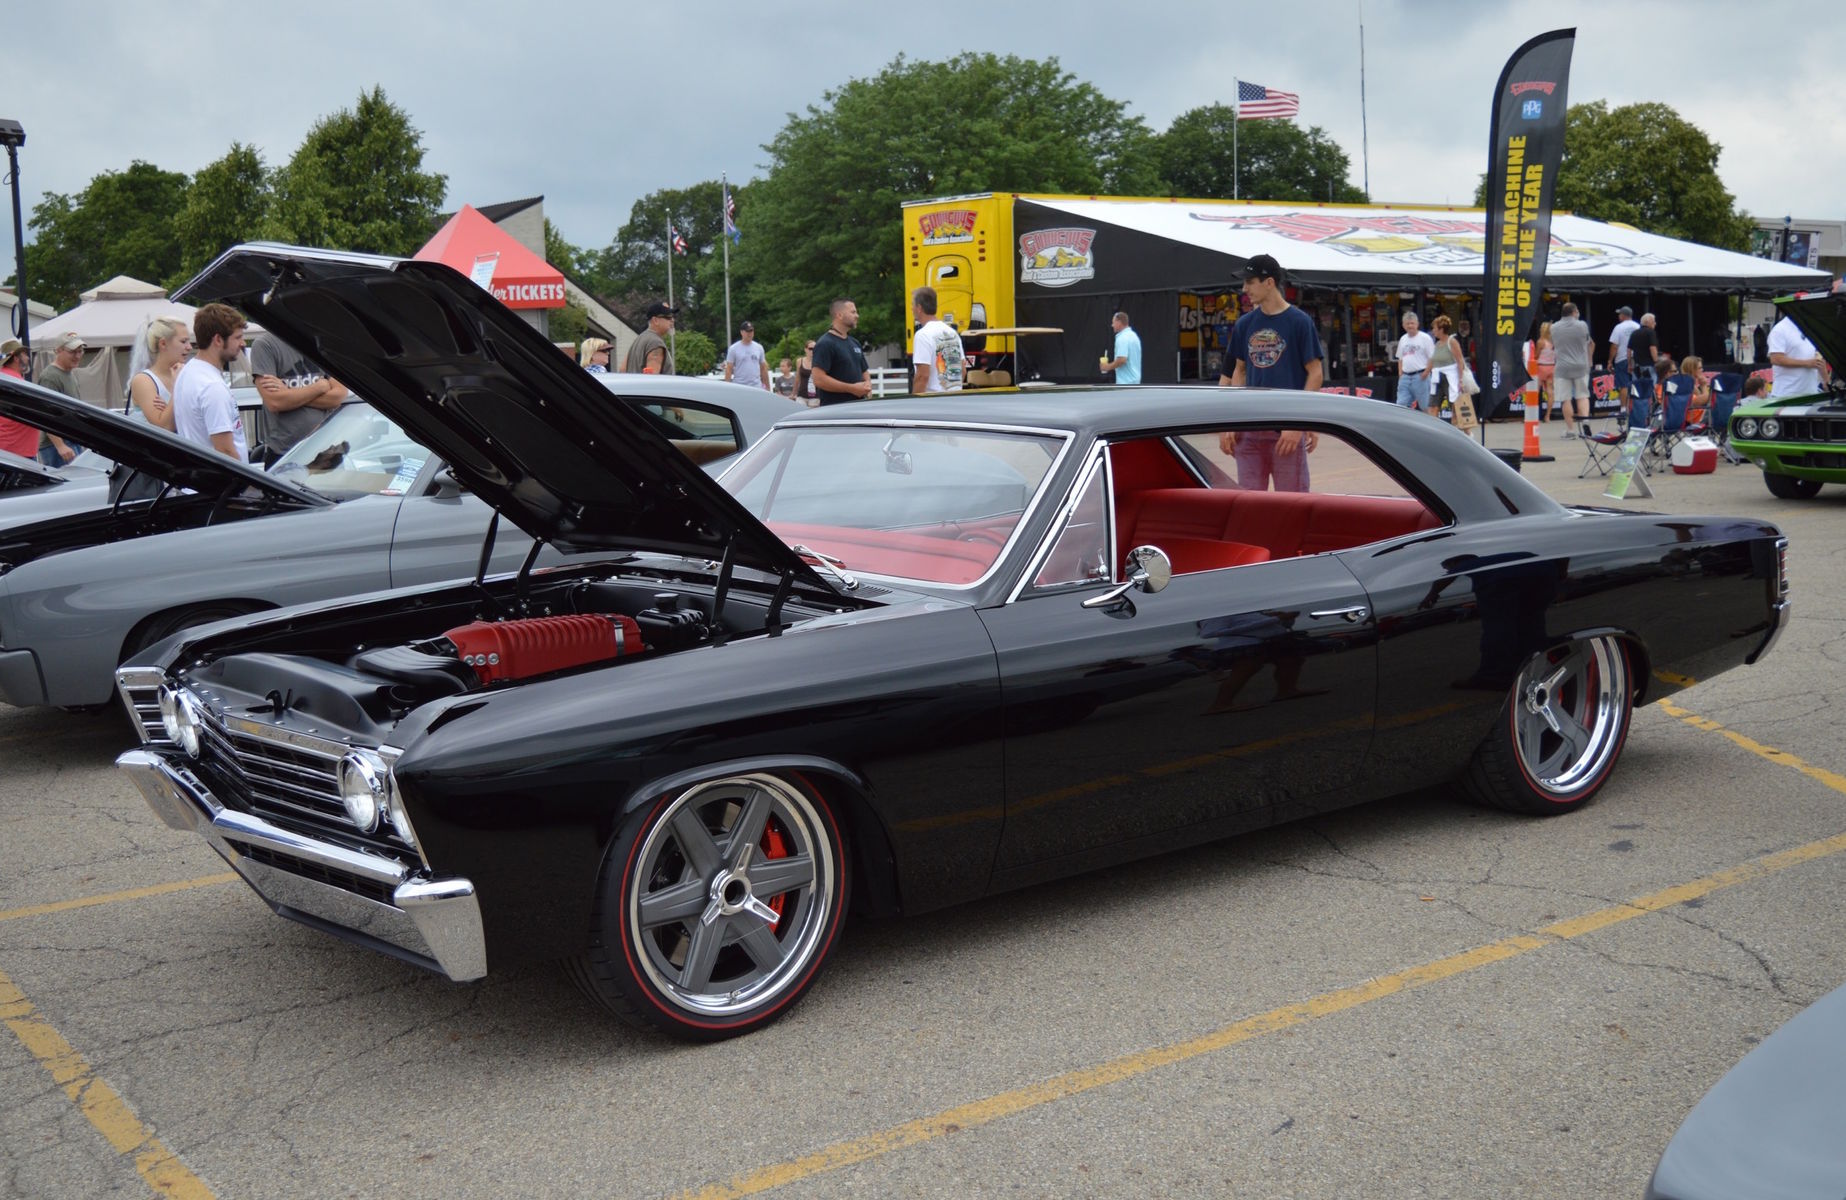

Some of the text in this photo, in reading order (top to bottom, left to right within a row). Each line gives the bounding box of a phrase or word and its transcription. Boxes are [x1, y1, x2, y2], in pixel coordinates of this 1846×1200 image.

[1523, 100, 1542, 116] PPG
[1497, 135, 1527, 335] STREET MACHINE
[1516, 164, 1544, 307] OF THE YEAR
[507, 284, 564, 301] TICKETS
